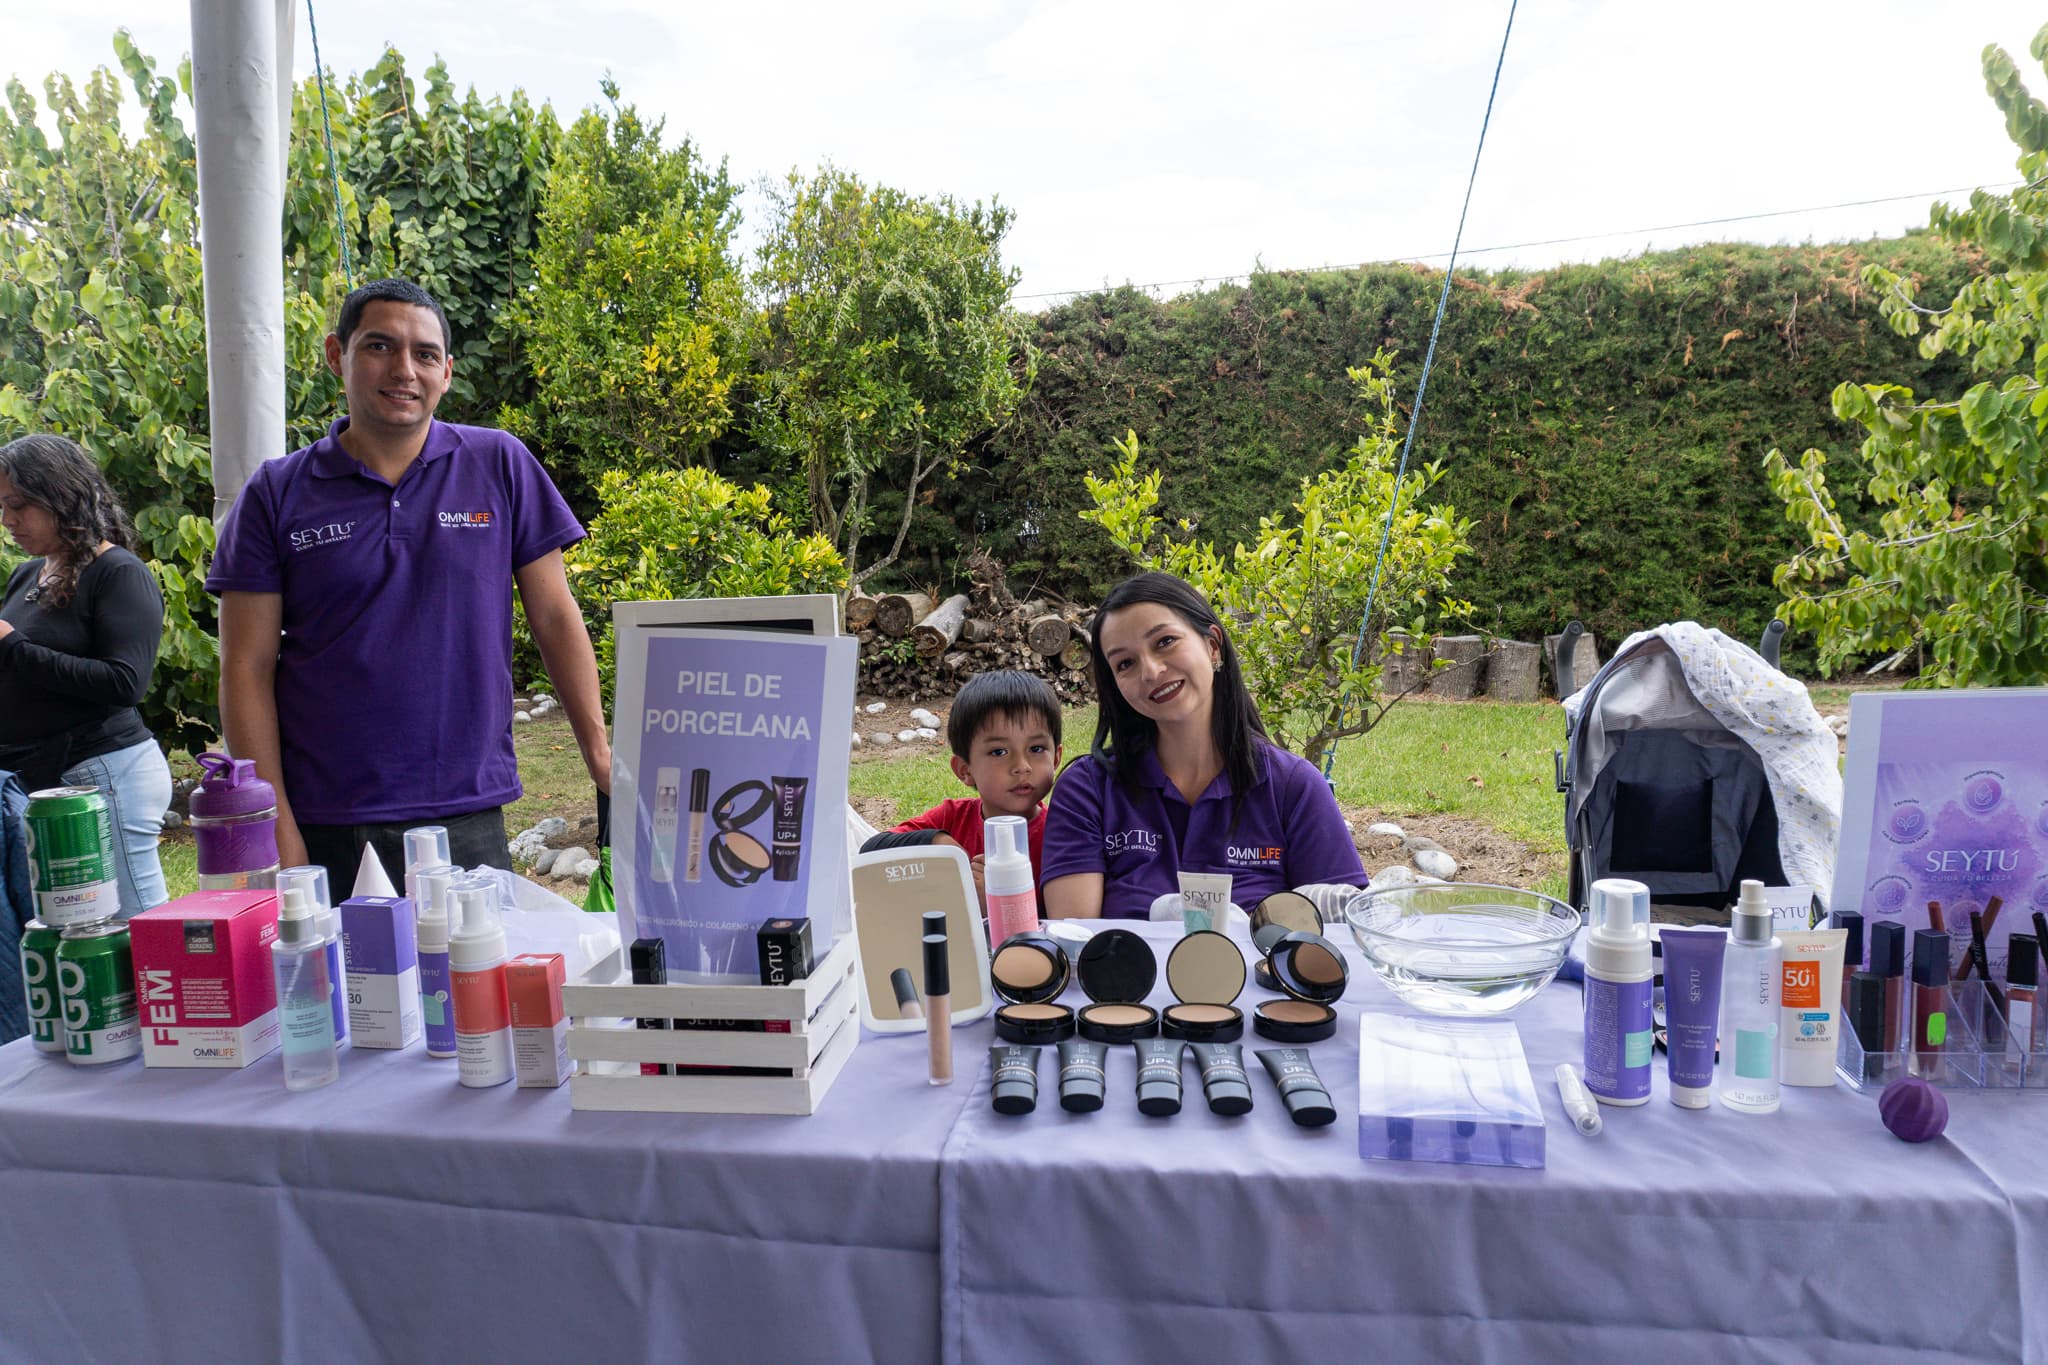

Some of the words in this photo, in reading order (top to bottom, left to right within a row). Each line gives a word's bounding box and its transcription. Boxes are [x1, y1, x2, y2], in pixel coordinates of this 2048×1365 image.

[438, 511, 490, 523] OMNILIFE
[677, 670, 737, 697] PIEL
[744, 672, 782, 699] DE
[644, 708, 812, 741] PORCELANA
[1227, 846, 1281, 860] OMNILIFE
[1925, 849, 2019, 873] SEYTÚ
[768, 942, 784, 985] EYTÚ
[23, 949, 55, 1042] EGO
[59, 960, 93, 1056] EGO
[148, 969, 180, 1047] FEM
[348, 993, 362, 1005] 30
[193, 1047, 237, 1057] OMNILIFE
